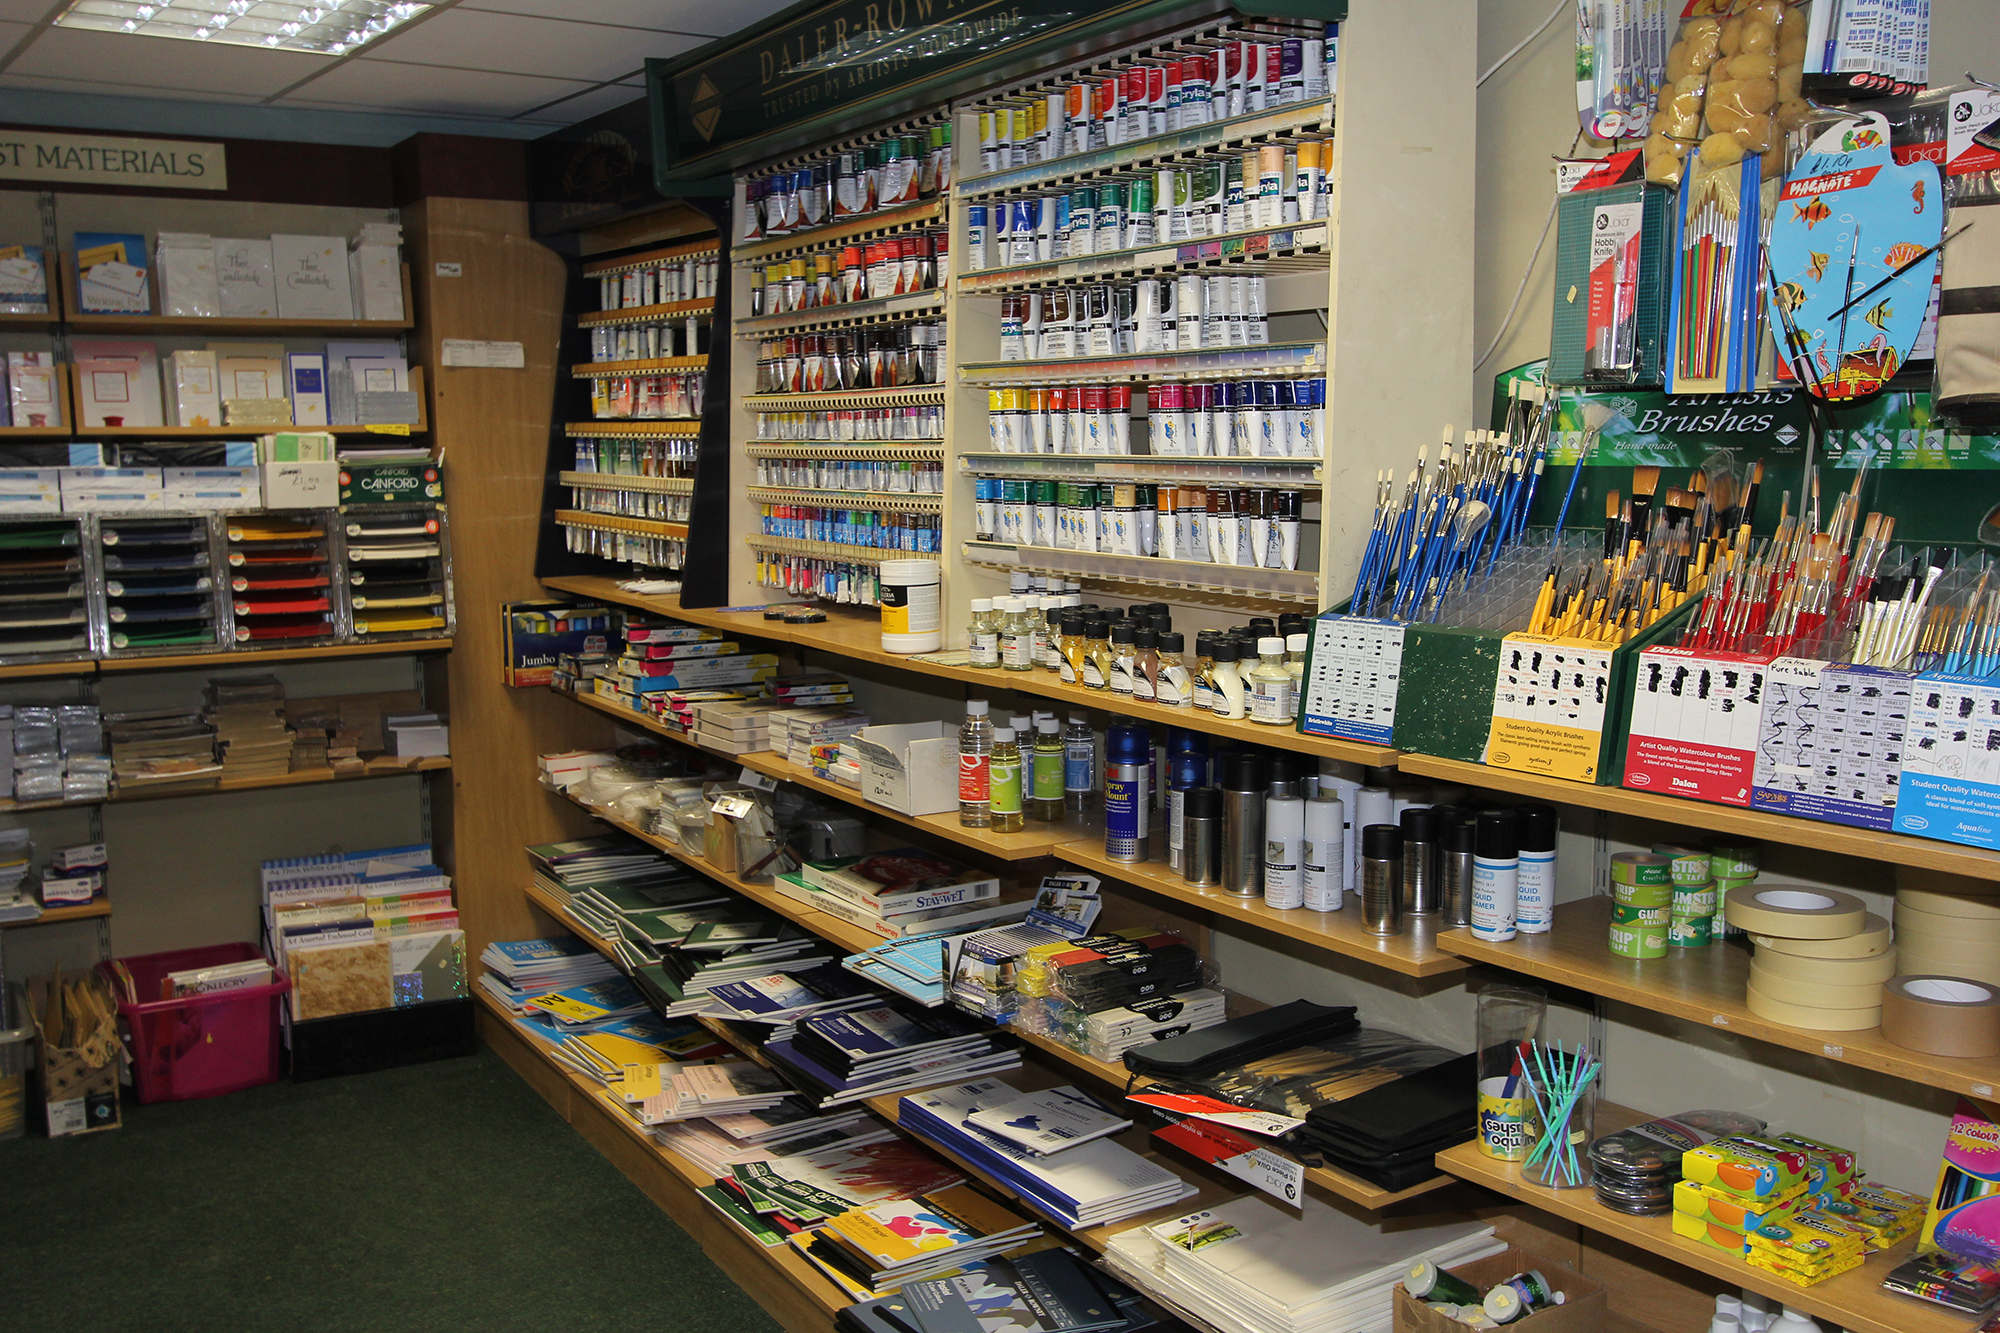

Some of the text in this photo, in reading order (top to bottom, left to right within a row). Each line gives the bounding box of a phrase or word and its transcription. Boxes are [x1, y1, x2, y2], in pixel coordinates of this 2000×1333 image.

[763, 7, 1020, 118] TRUSTED by ARTISTS WORLDWIDE
[36, 145, 204, 176] MATERIALS
[1901, 145, 1946, 165] Jakar
[1790, 175, 1852, 195] MAGNATE
[1609, 217, 1630, 227] Jakar
[1594, 248, 1613, 256] Knife
[1635, 408, 1774, 434] Brushes
[1615, 441, 1677, 450] Hand made
[361, 477, 418, 489] CANFORD
[1648, 647, 1695, 656] Dalon
[522, 654, 556, 667] Jumbo
[1771, 665, 1816, 677] Pure Sable
[1926, 672, 1989, 683] Aquafine
[1506, 723, 1525, 731] Student
[1526, 726, 1544, 735] Quality
[1564, 732, 1584, 740] Brushes
[1517, 735, 1538, 743] best-selling
[1640, 741, 1741, 762] Artist Quality Watercolour Brushes
[1658, 755, 1678, 763] synthetic
[1679, 758, 1706, 766] watercolour
[1720, 763, 1742, 773] featuring
[1685, 765, 1705, 773] Japanese
[1719, 769, 1732, 777] fibres
[1106, 782, 1125, 792] Spray
[1672, 778, 1698, 788] Dalon
[1911, 779, 1969, 795] Student Quality
[1106, 792, 1128, 801] Mount
[1931, 795, 1948, 803] classic
[1951, 804, 1994, 816] watercolourists
[1956, 822, 1992, 834] Aquafine
[282, 863, 342, 874] Thick White Card
[384, 902, 411, 911] Assorted
[862, 896, 879, 910] Rowney
[390, 923, 416, 931] Assorted
[876, 922, 899, 938] Rowney
[299, 935, 326, 944] Assorted
[328, 932, 358, 940] Embossed
[359, 929, 373, 937] Card
[1611, 943, 1628, 952] TAPE
[196, 978, 247, 993] GALLERY
[1045, 1101, 1091, 1122] Westminster
[1153, 1108, 1165, 1117] case
[1953, 1124, 1999, 1142] 12 COLOUR
[1268, 1166, 1288, 1180] Piece
[1288, 1173, 1296, 1183] 16
[1265, 1175, 1284, 1189] Jakar
[807, 1195, 823, 1205] Pad
[927, 1204, 969, 1230] DALER ROWNEY
[852, 1214, 889, 1239] Acrylic Paper
[936, 1280, 953, 1296] Pastel
[1014, 1281, 1046, 1317] DALER ROWNEY
